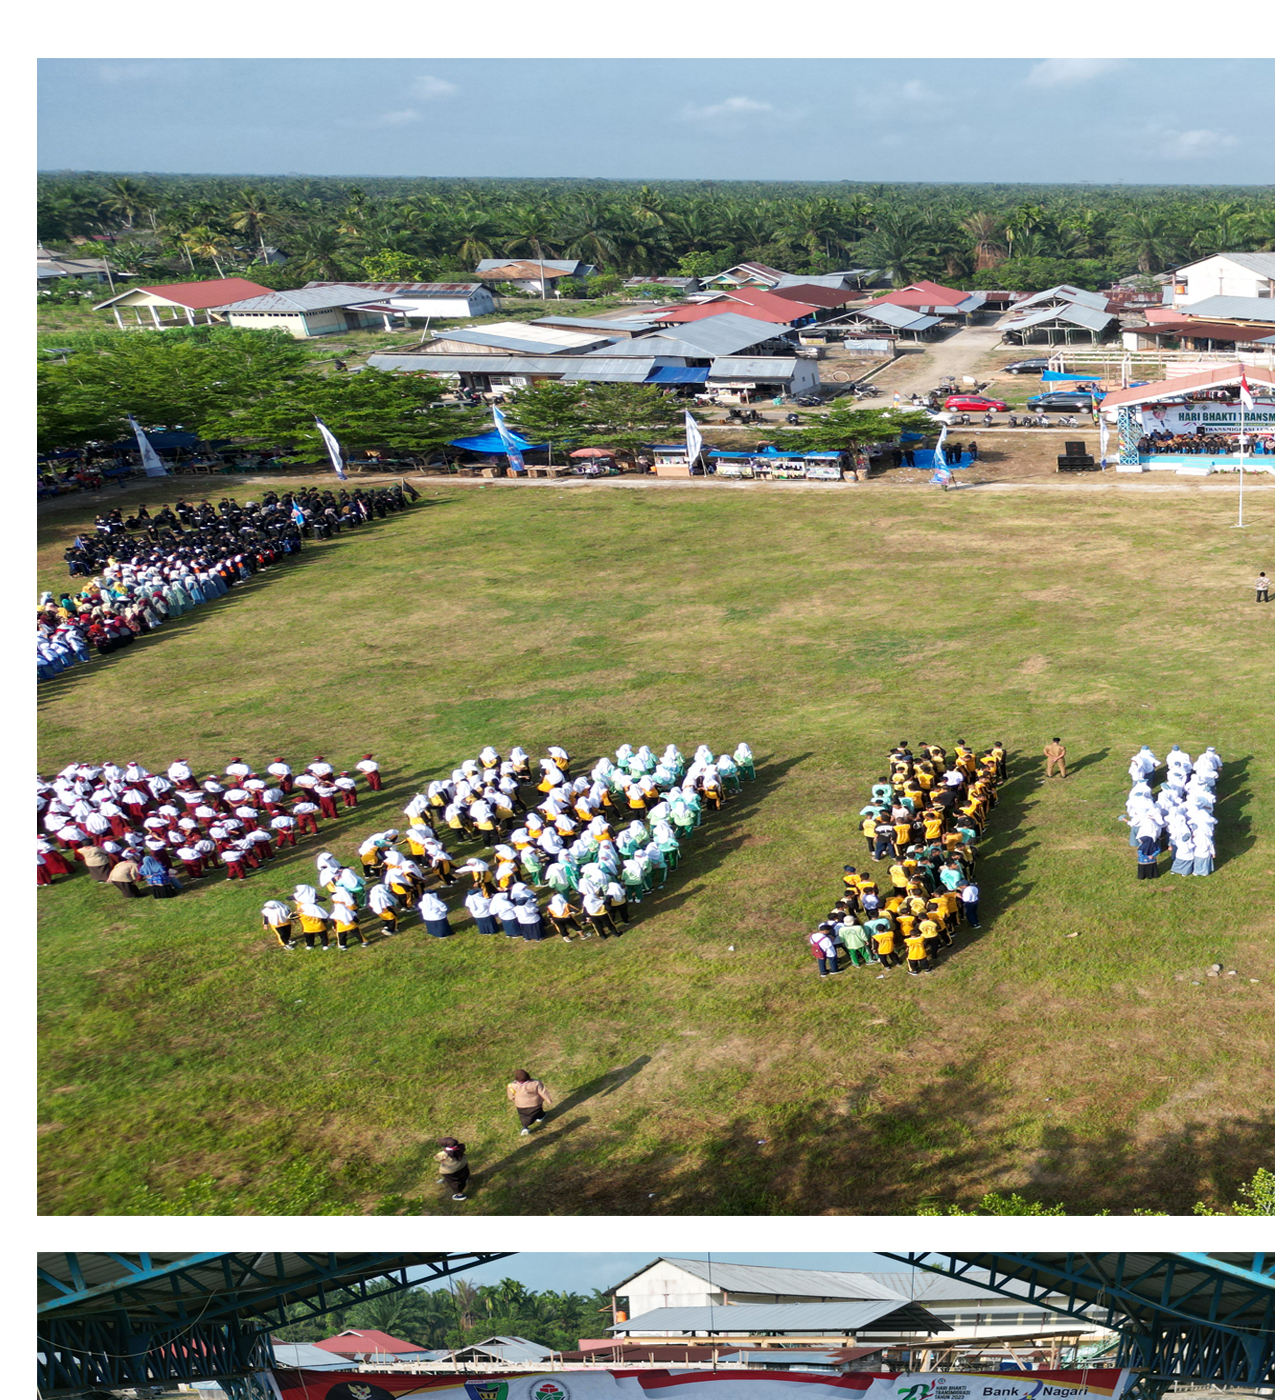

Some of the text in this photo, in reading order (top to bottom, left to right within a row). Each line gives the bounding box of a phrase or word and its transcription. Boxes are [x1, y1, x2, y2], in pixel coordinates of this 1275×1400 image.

[1178, 412, 1200, 422] HARI
[1202, 412, 1236, 422] BHAKTI
[982, 1386, 1089, 1398] Bank Nagari
